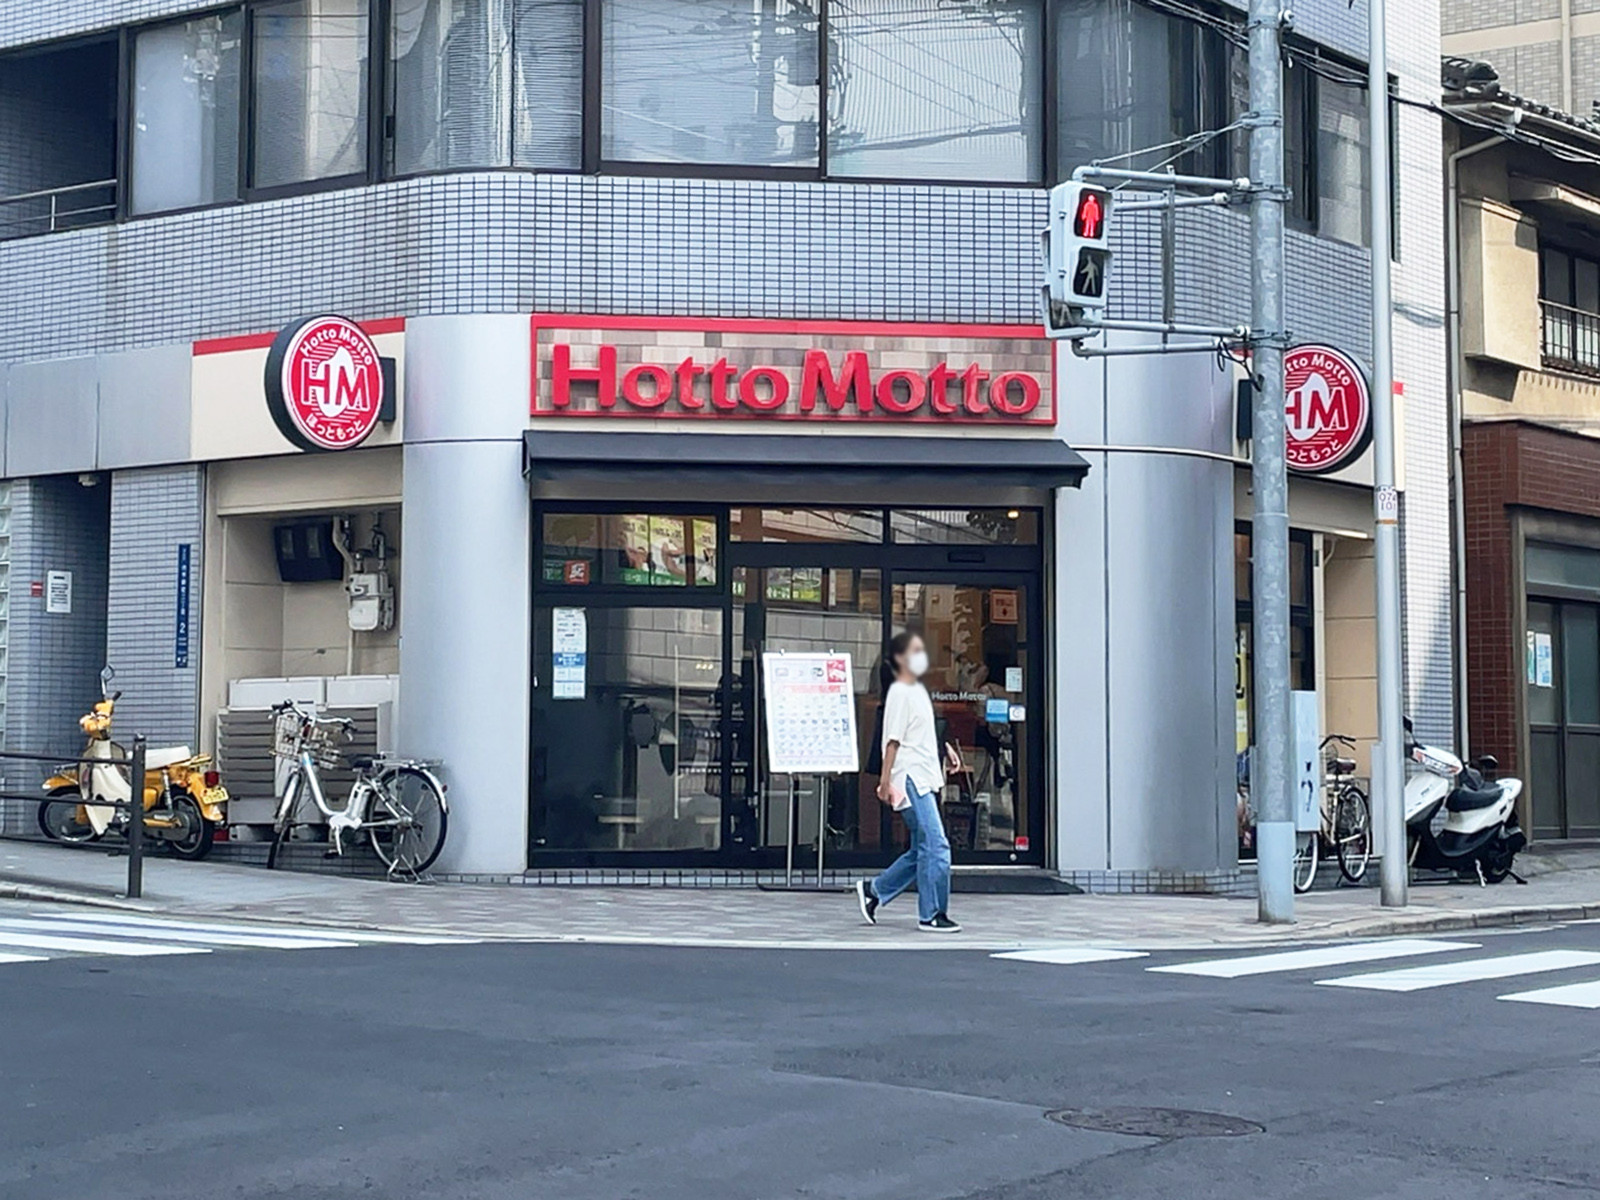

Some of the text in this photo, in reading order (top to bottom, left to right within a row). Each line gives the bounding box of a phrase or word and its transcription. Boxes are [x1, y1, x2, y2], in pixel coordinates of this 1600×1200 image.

[300, 326, 373, 366] Hotto Motto
[301, 358, 371, 411] HM
[552, 344, 1041, 415] Hotto Motto
[1284, 353, 1351, 386] tto Motto
[305, 413, 365, 441] ほっともっと
[1285, 440, 1343, 462] っともっと
